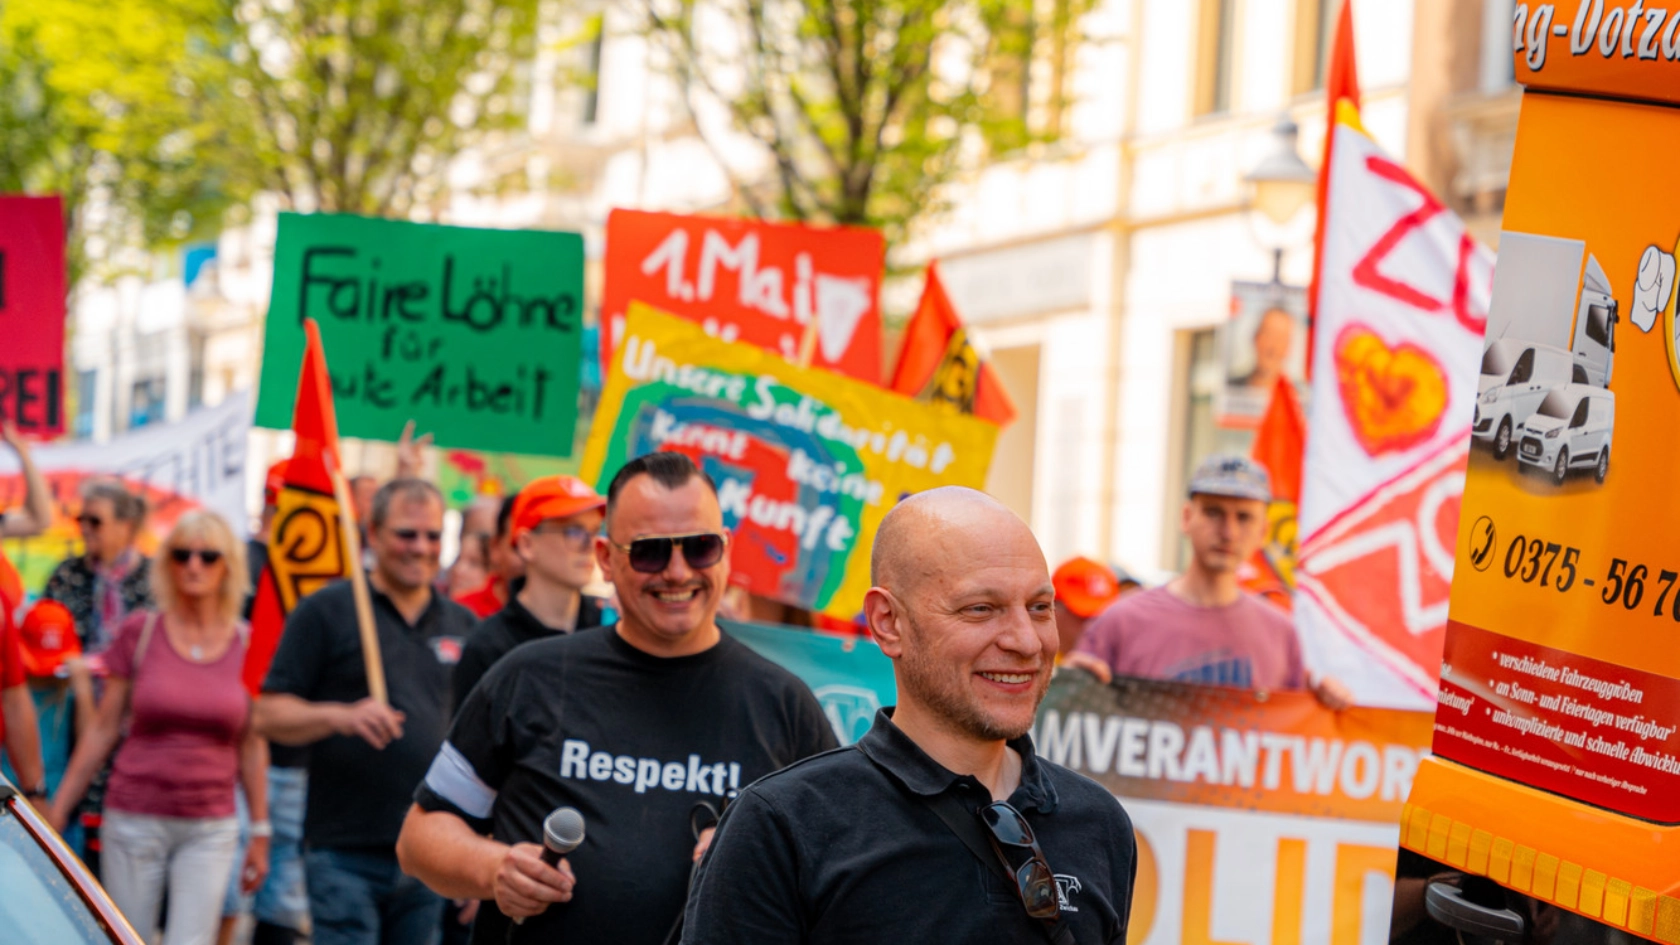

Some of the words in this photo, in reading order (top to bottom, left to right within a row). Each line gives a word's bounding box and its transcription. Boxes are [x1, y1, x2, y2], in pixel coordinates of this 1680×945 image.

[298, 246, 427, 327] Faire
[441, 254, 575, 332] Löhne
[329, 363, 397, 408] ute
[411, 363, 552, 421] Arbeit
[622, 336, 748, 401] Unsere
[1503, 534, 1581, 593] 0375
[1602, 557, 1648, 610] 56
[1496, 682, 1510, 697] an
[1510, 682, 1538, 704] Sonn-
[1539, 694, 1561, 711] und
[1560, 696, 1614, 727] Feiertagen
[1500, 653, 1560, 682] verschiedene
[1560, 666, 1643, 704] Fahrzeuggrößen
[1492, 709, 1564, 741] unkomplizierte
[1563, 731, 1587, 748] und
[1586, 736, 1630, 761] schnelle
[560, 739, 741, 798] Respekt!
